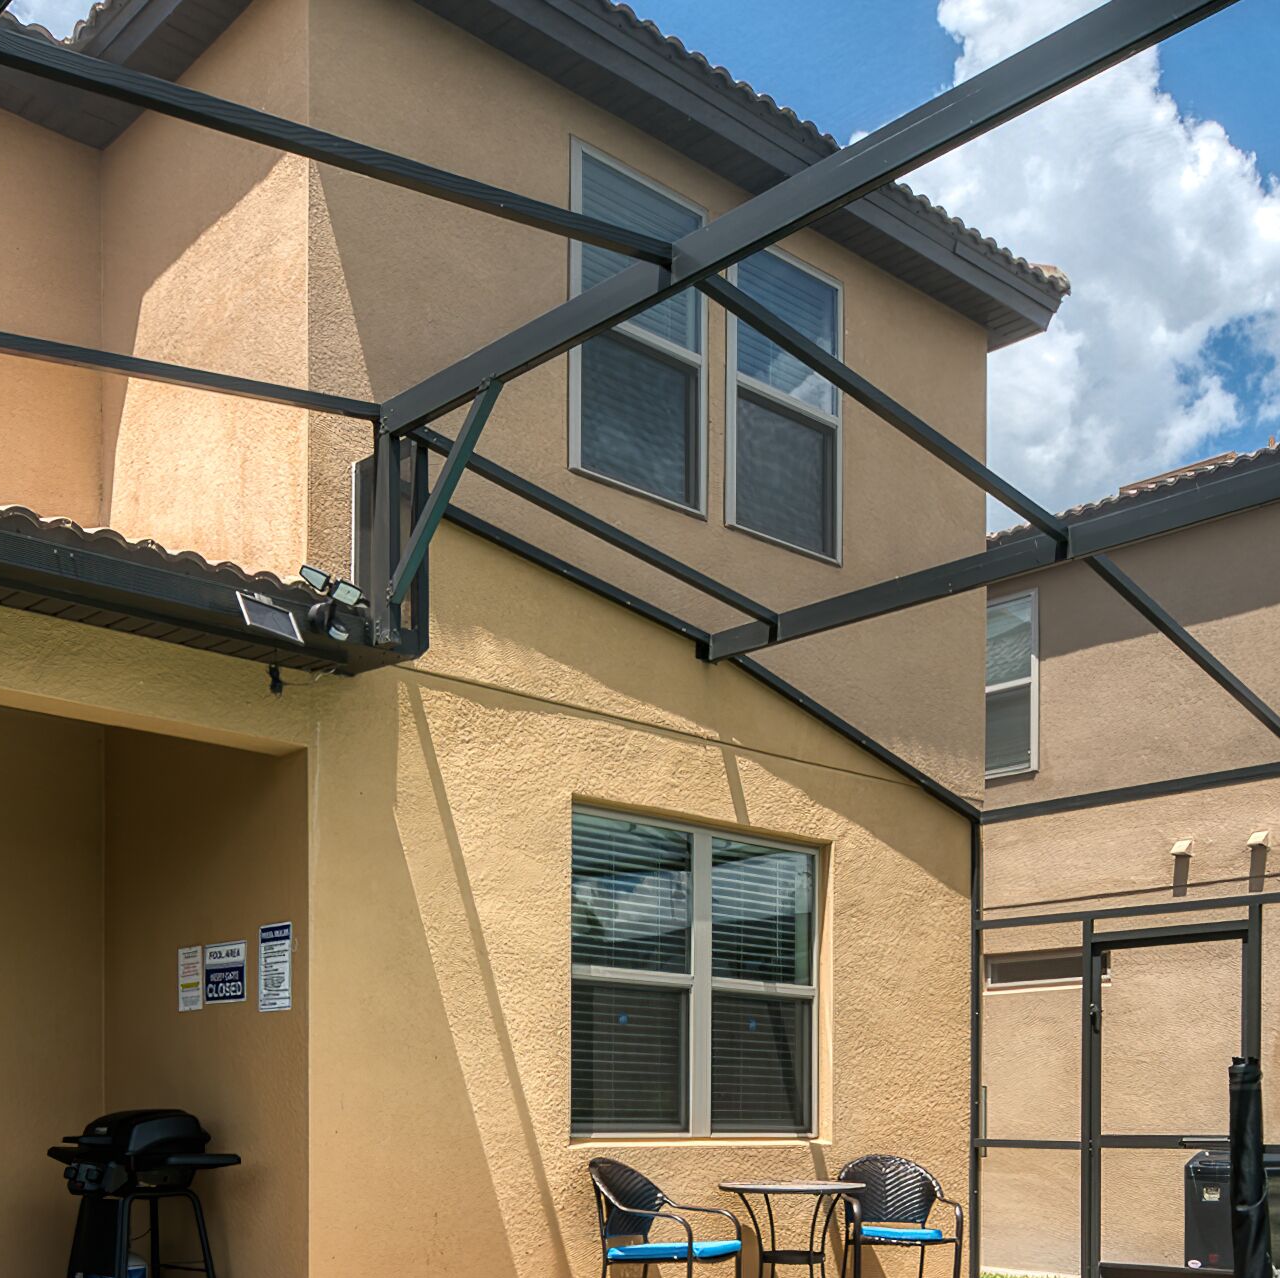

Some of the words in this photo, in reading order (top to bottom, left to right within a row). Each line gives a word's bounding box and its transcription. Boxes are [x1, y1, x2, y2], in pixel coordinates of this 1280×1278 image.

[208, 951, 224, 960] POOL
[225, 948, 241, 957] AREA
[206, 981, 243, 998] CLOSED
